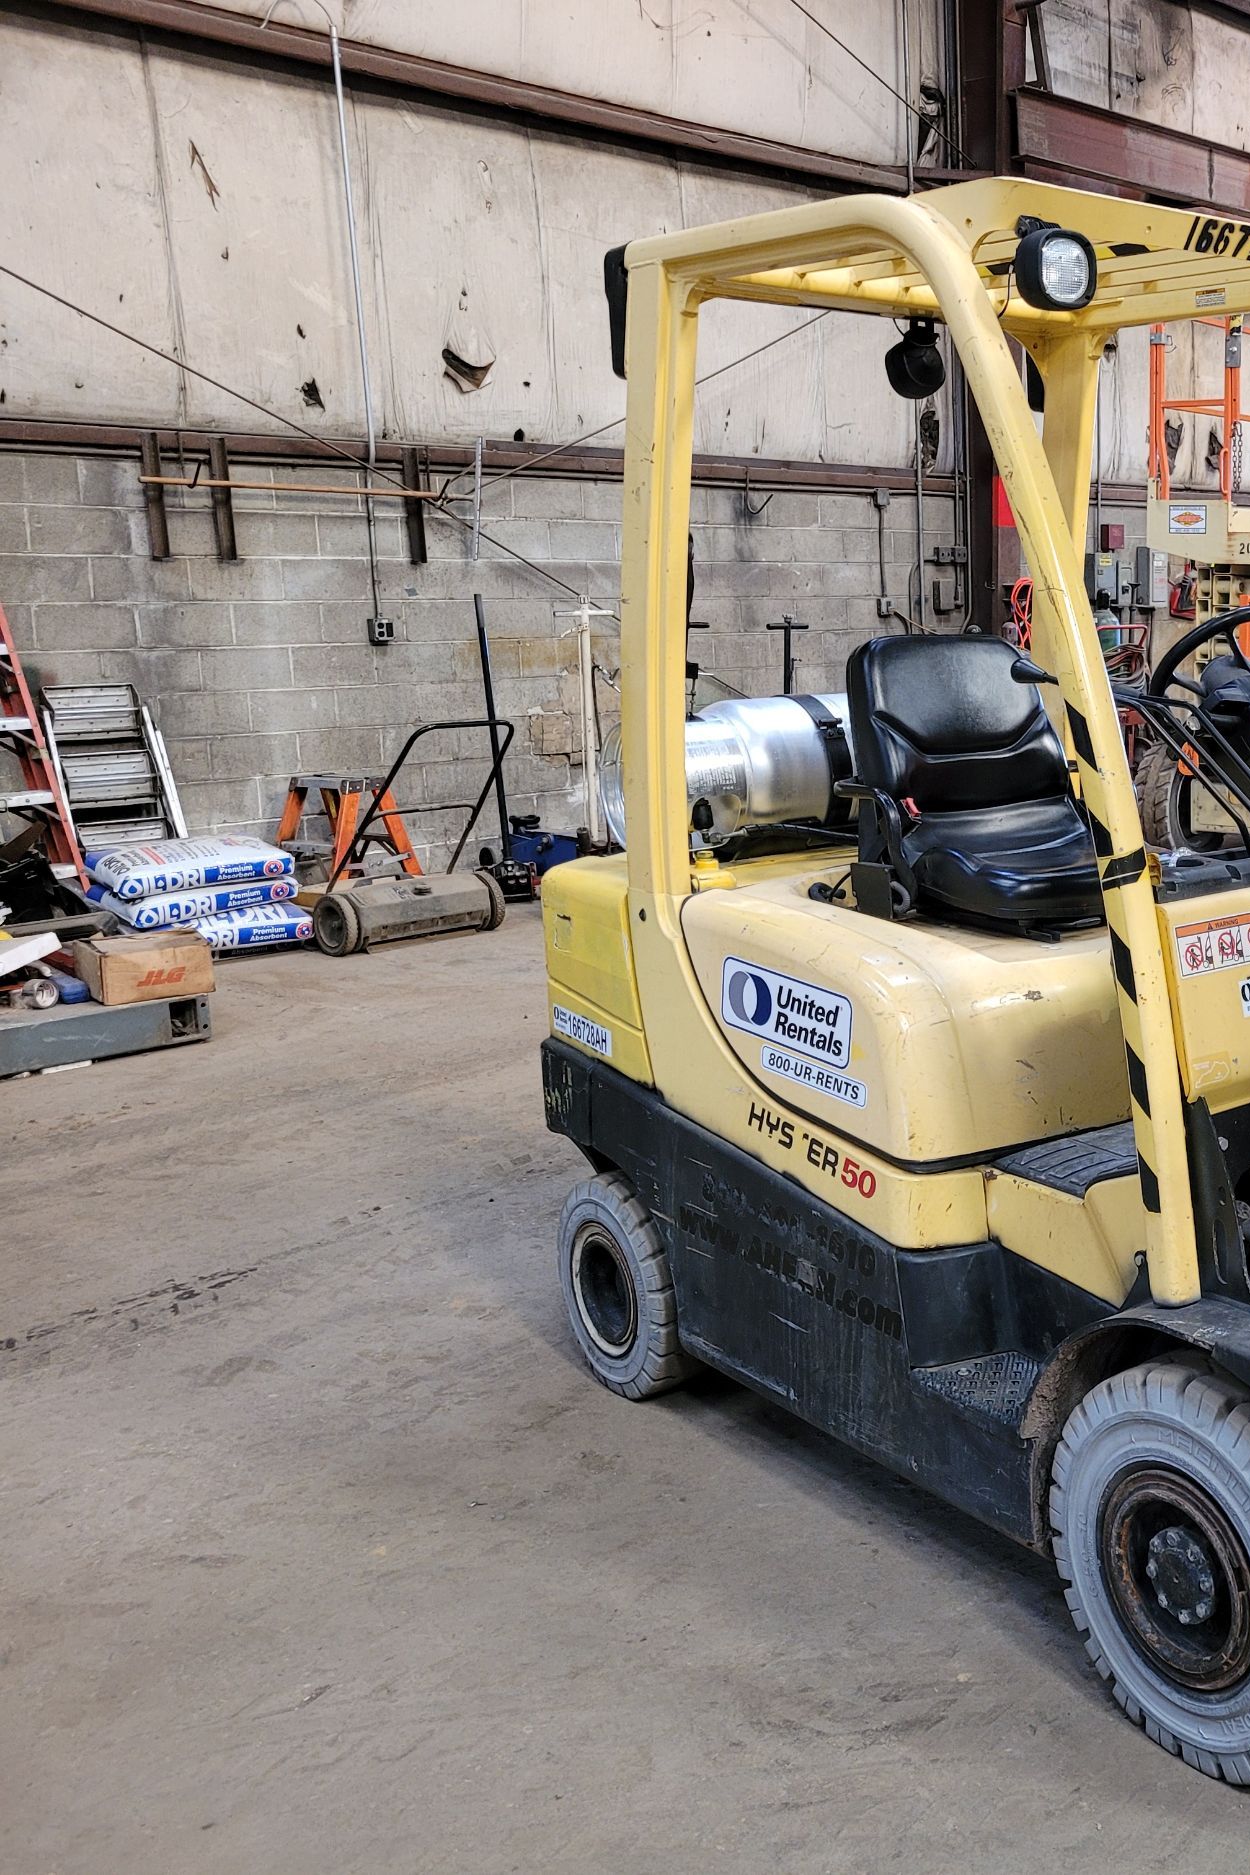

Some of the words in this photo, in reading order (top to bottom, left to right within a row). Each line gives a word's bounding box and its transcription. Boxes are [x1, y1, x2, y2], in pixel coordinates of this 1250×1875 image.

[217, 871, 256, 881] Absorbent
[219, 864, 253, 875] Premium
[227, 895, 263, 908] Absorbent
[229, 889, 261, 901] Premium
[1214, 918, 1239, 929] WARNING
[250, 933, 288, 942] Absorbent
[252, 926, 286, 936] Premium
[136, 966, 186, 987] JLG
[776, 985, 840, 1028] United
[568, 1013, 607, 1053] 166728AH
[774, 1011, 844, 1057] Rentals
[768, 1052, 860, 1100] 800-UR-RENTS
[747, 1101, 839, 1178] HYSER
[840, 1157, 877, 1199] 50
